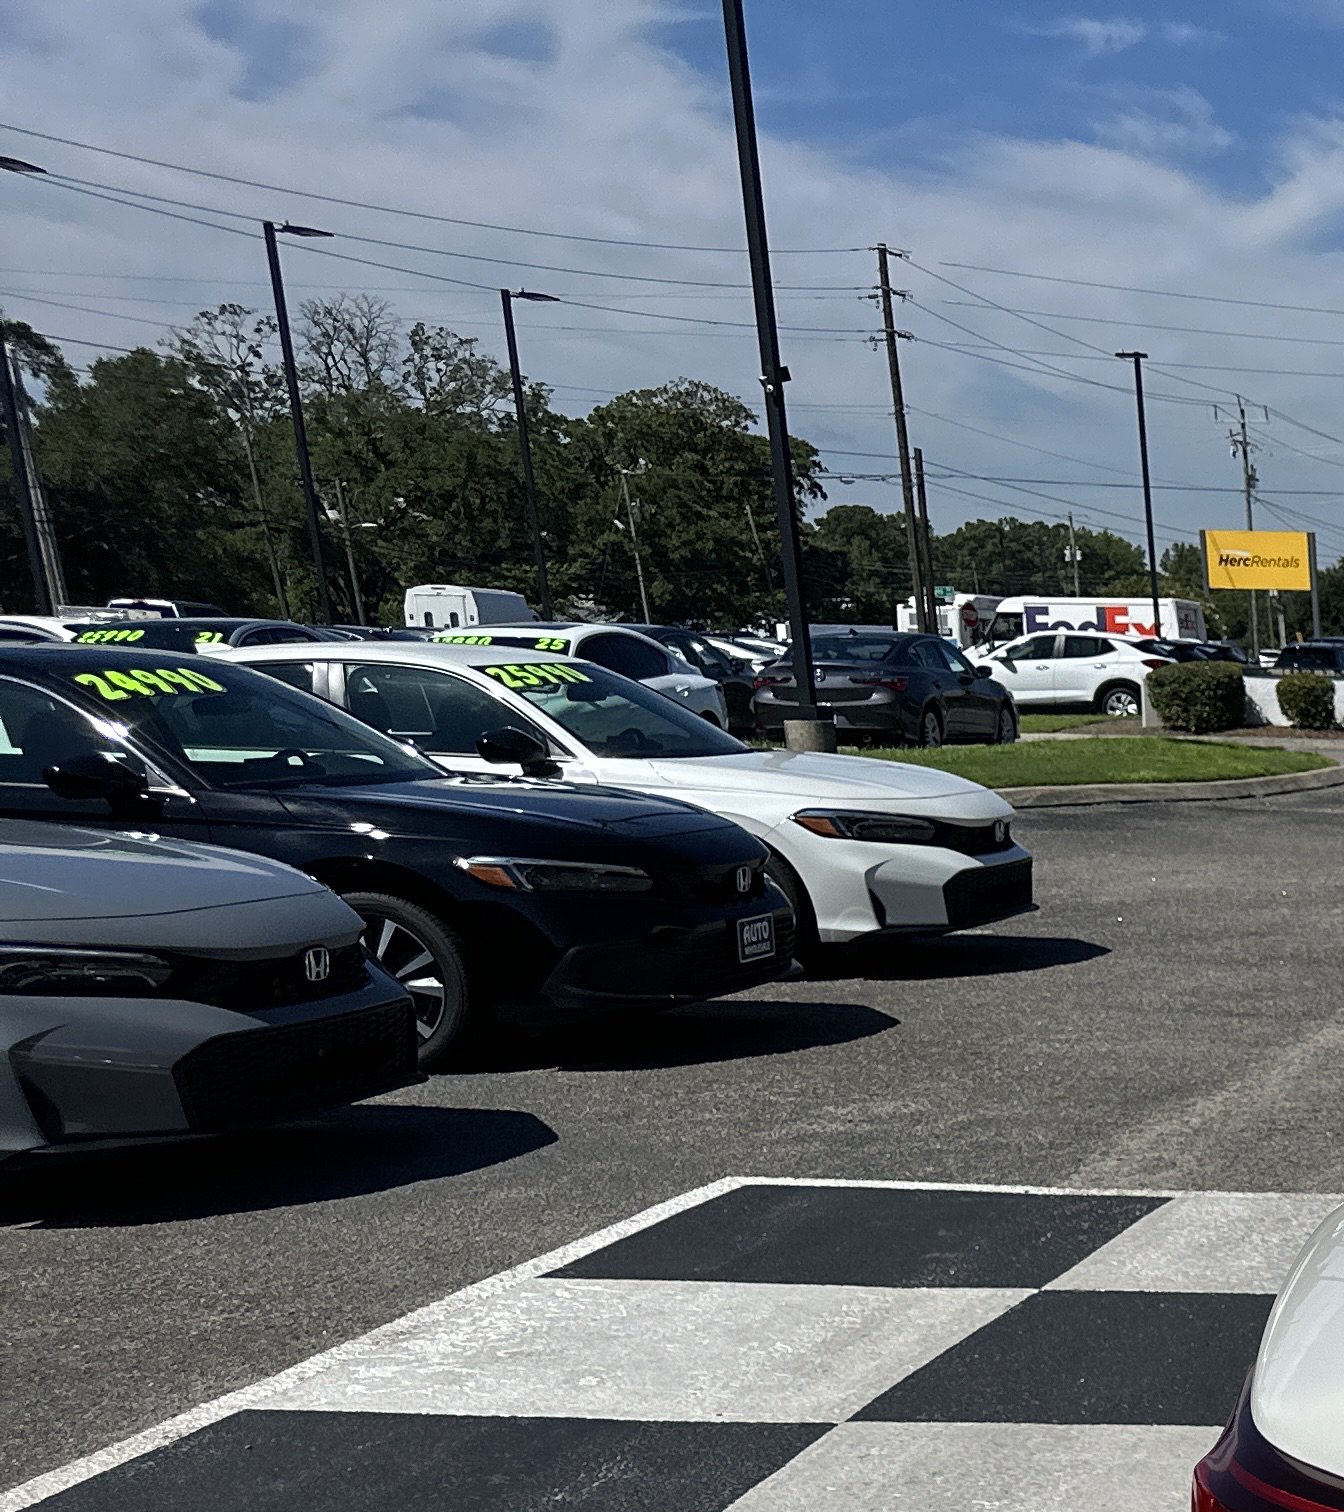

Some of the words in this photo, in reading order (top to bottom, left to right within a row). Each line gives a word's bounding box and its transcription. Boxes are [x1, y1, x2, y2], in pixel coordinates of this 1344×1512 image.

[1218, 553, 1301, 568] HercRentals
[534, 638, 567, 650] 25
[74, 667, 229, 701] 24990
[484, 663, 595, 689] 25990
[743, 920, 770, 946] AUTO
